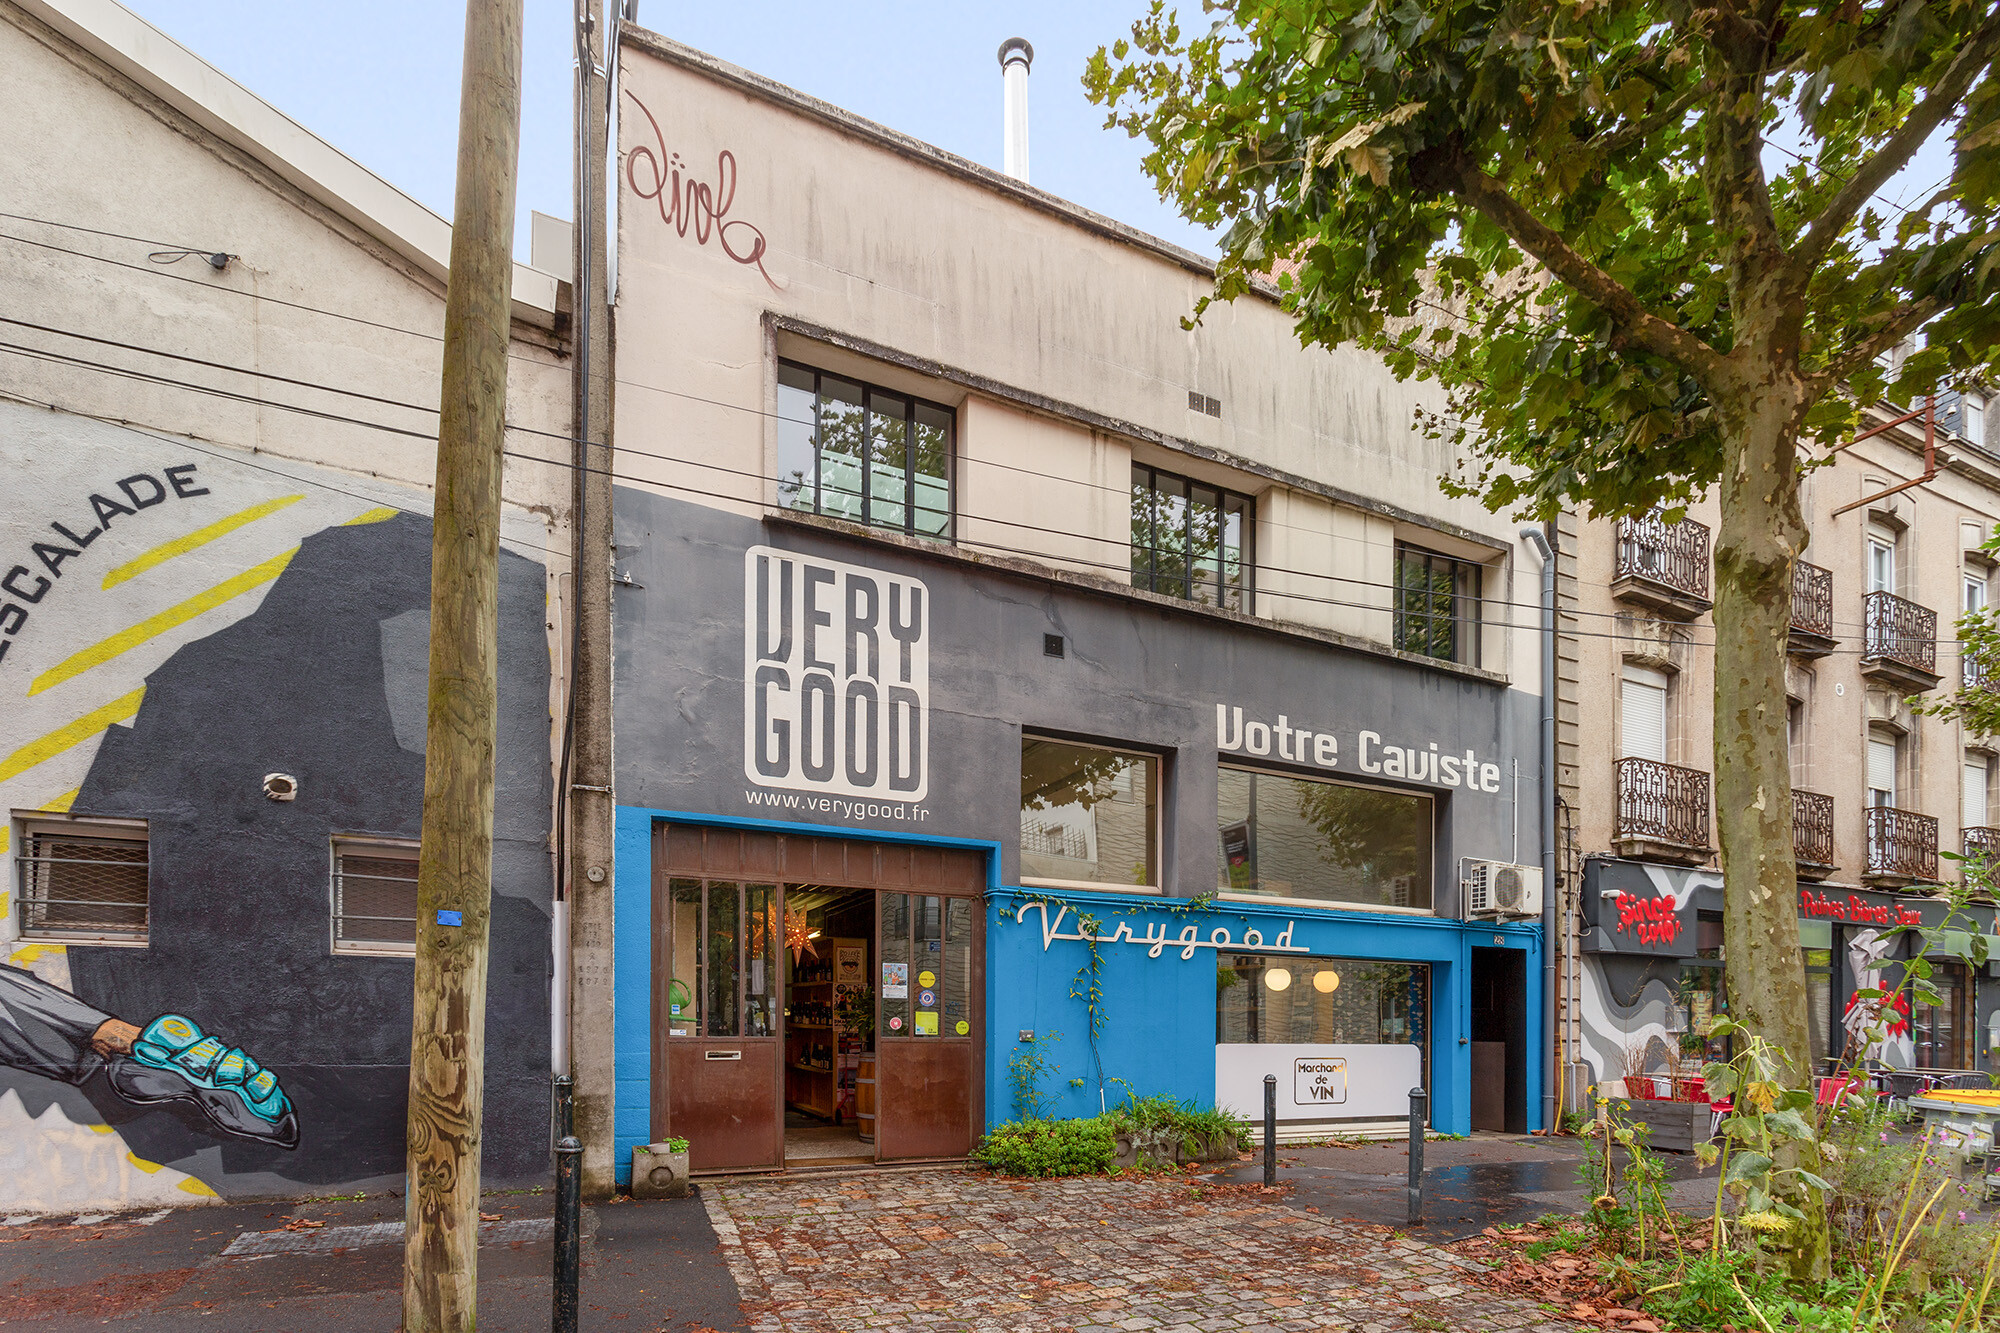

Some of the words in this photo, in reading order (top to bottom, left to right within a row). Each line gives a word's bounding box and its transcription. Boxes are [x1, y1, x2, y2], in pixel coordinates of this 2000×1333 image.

[755, 554, 923, 685] VERY
[754, 665, 922, 792] GOOD
[1216, 703, 1338, 767] Votre
[1358, 730, 1501, 793] Caviste
[745, 790, 930, 822] www.verygood.fr
[1615, 890, 1676, 930] Since
[1800, 890, 1845, 919] Poutines
[1894, 904, 1922, 925] Jeux
[1016, 901, 1311, 961] Verygood
[1637, 919, 1675, 946] 2010
[1298, 1063, 1344, 1073] Marchand
[1315, 1075, 1329, 1085] de
[1309, 1086, 1335, 1100] VIN
